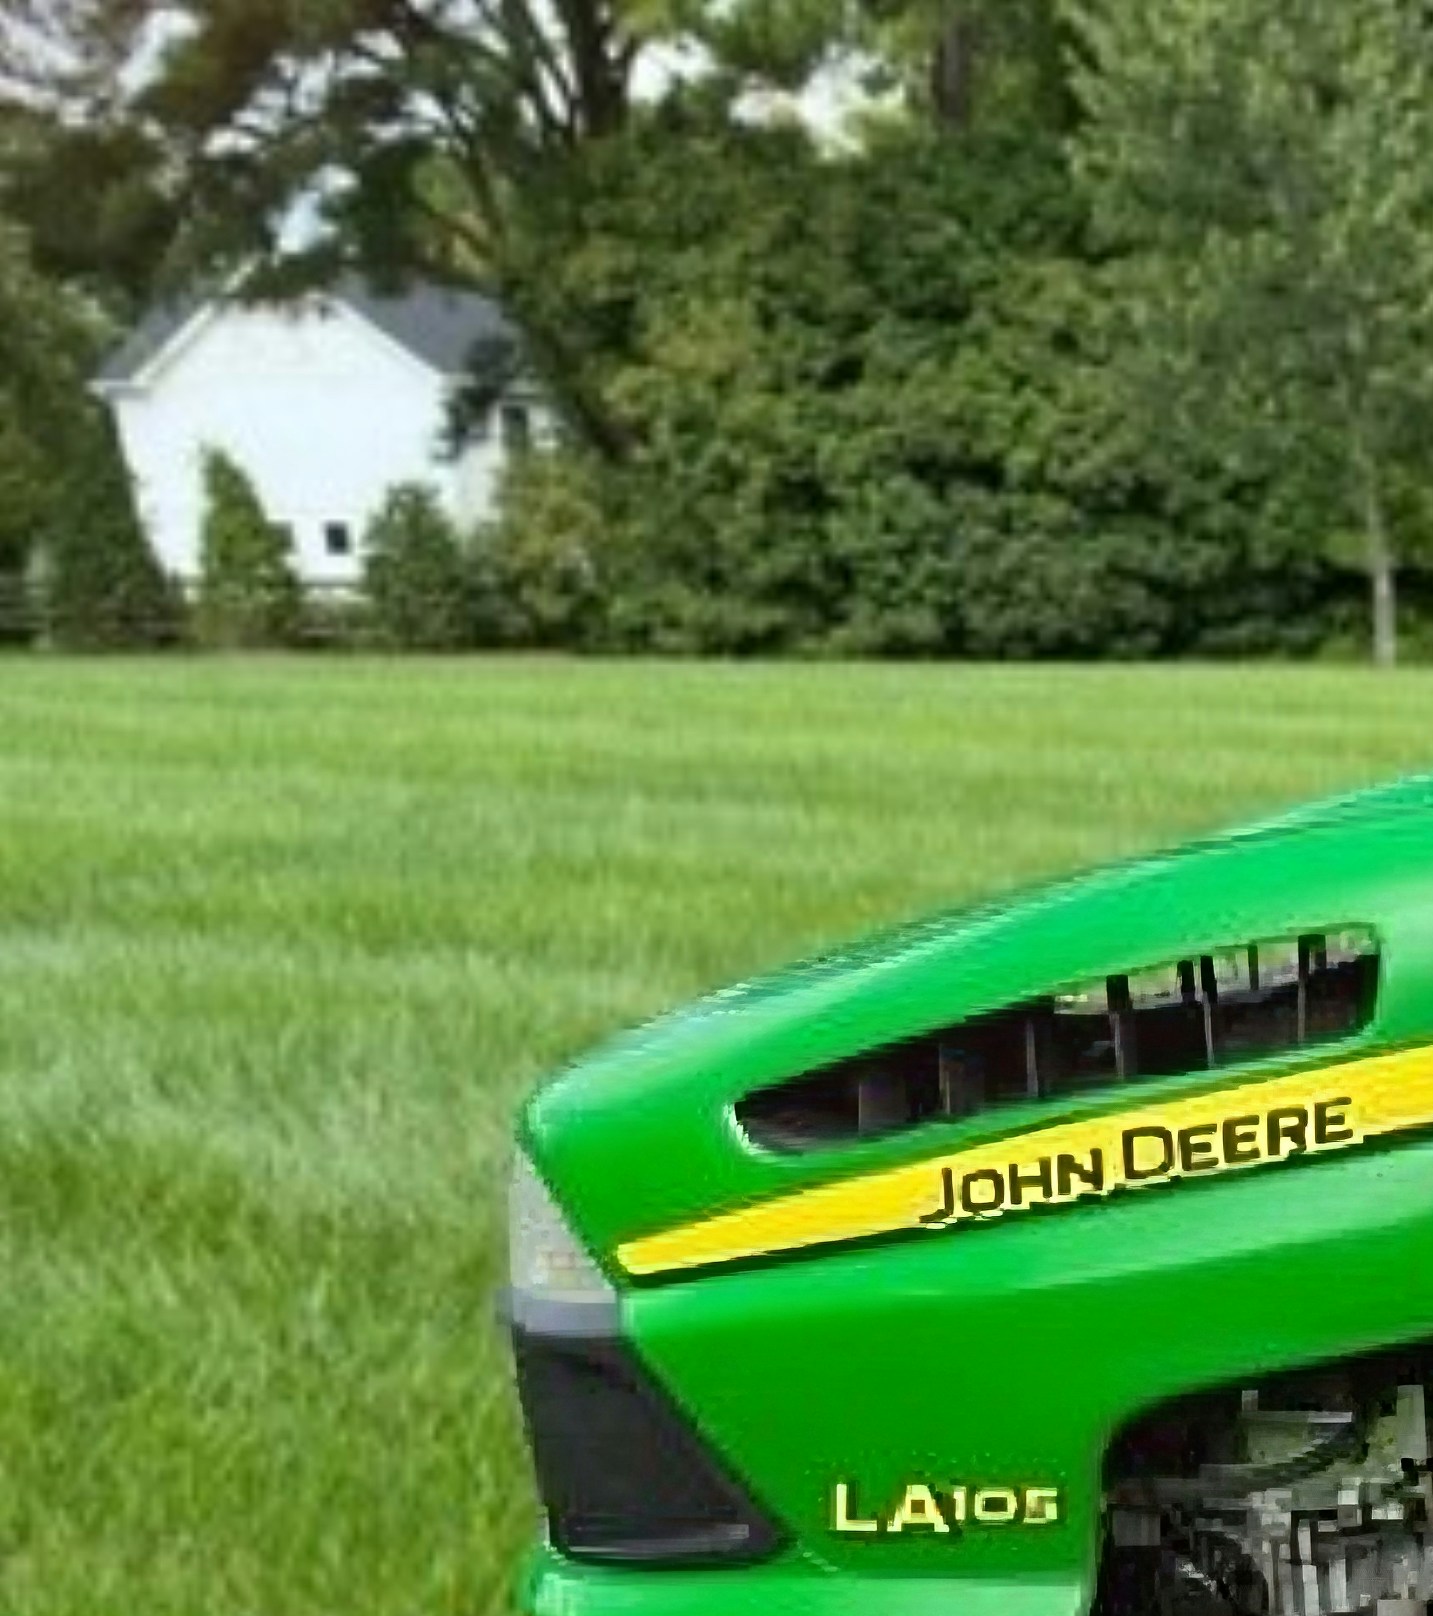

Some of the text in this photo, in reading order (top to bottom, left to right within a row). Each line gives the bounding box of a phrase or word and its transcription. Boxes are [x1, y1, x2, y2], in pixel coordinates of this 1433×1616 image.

[919, 1096, 1353, 1222] JOHN DEERE
[835, 1482, 1058, 1533] LA105
